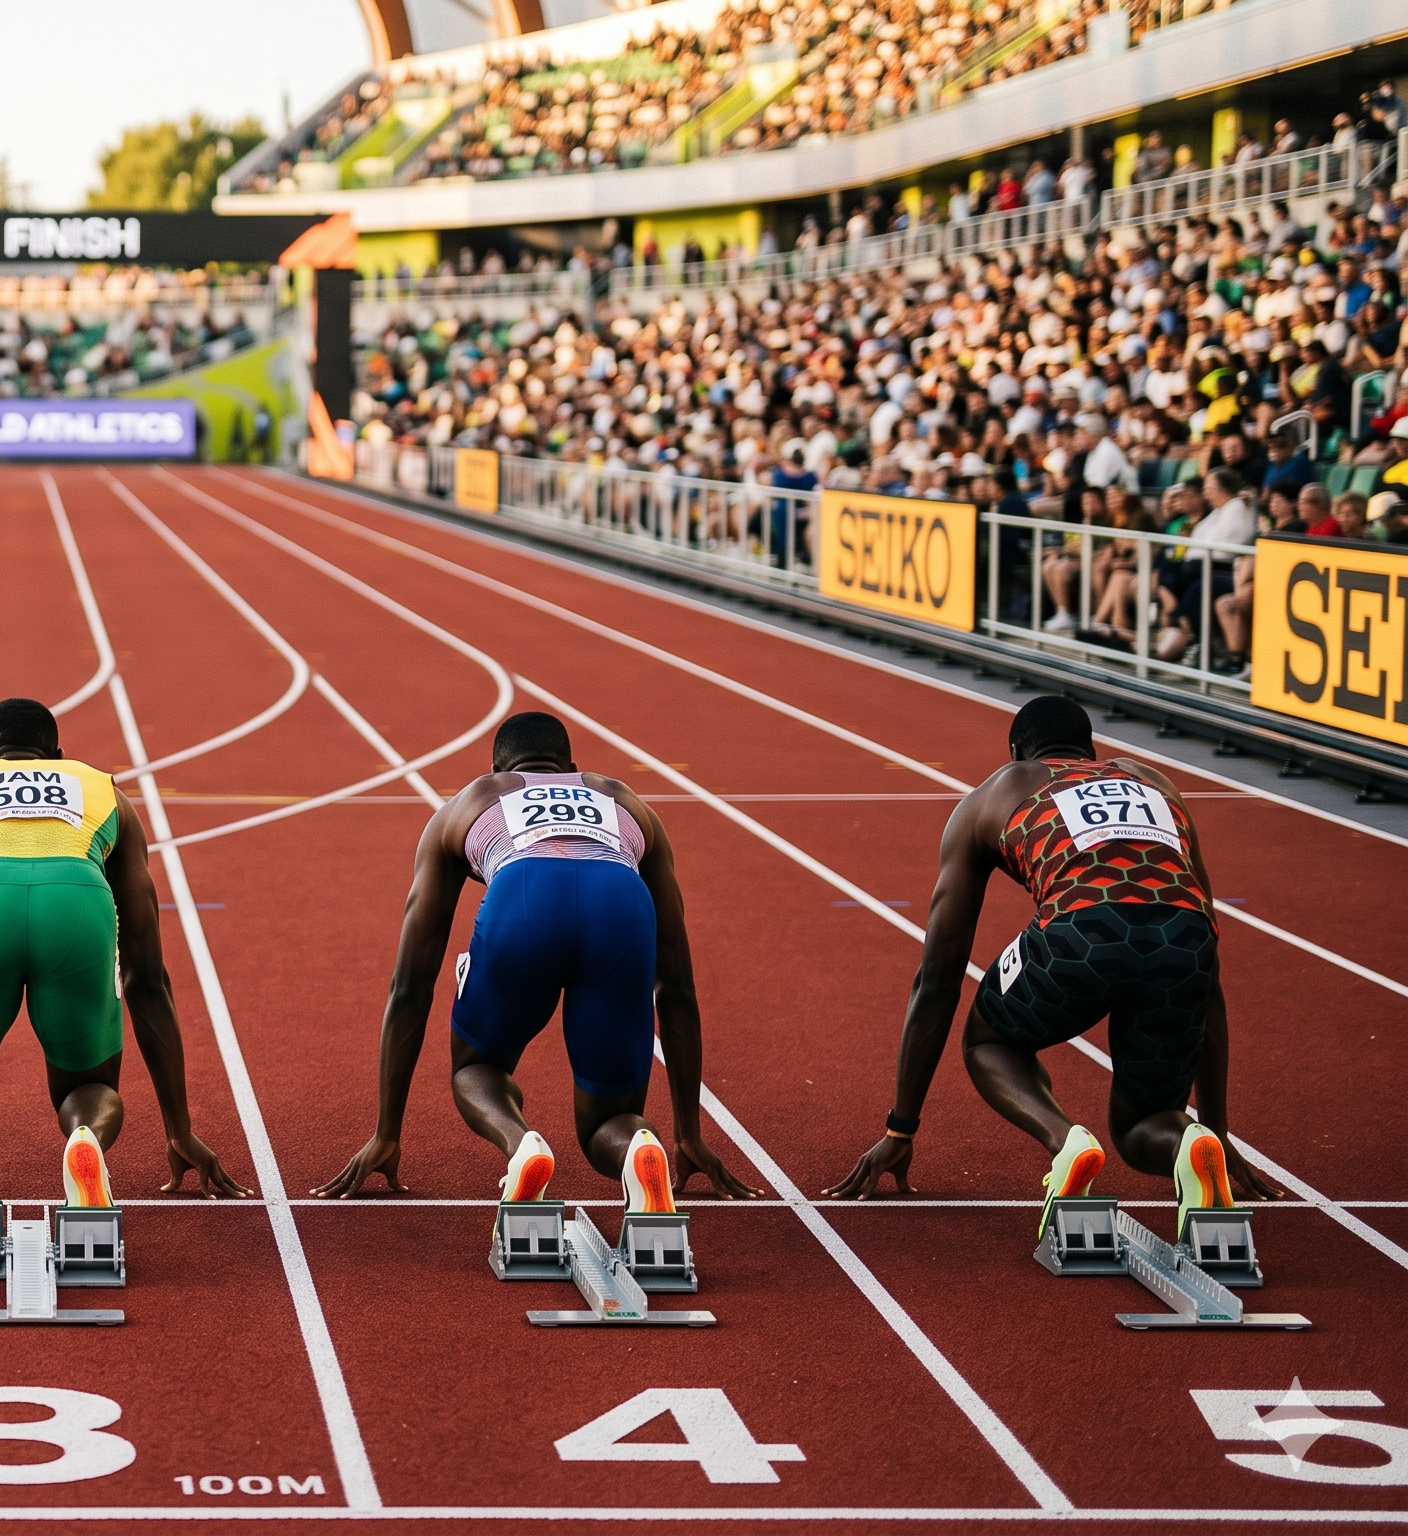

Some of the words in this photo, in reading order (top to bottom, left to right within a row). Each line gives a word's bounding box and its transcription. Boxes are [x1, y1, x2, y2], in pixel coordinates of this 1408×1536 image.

[3, 217, 141, 258] FINISH
[29, 412, 184, 443] ATHLETICS
[838, 507, 951, 609] SEIKO
[522, 787, 594, 802] GBR
[1074, 782, 1147, 800] KEN
[521, 803, 603, 827] 299
[1080, 801, 1158, 826] 671
[554, 1387, 807, 1483] 4
[1189, 1390, 1408, 1486] 5
[173, 1475, 326, 1496] 100M
